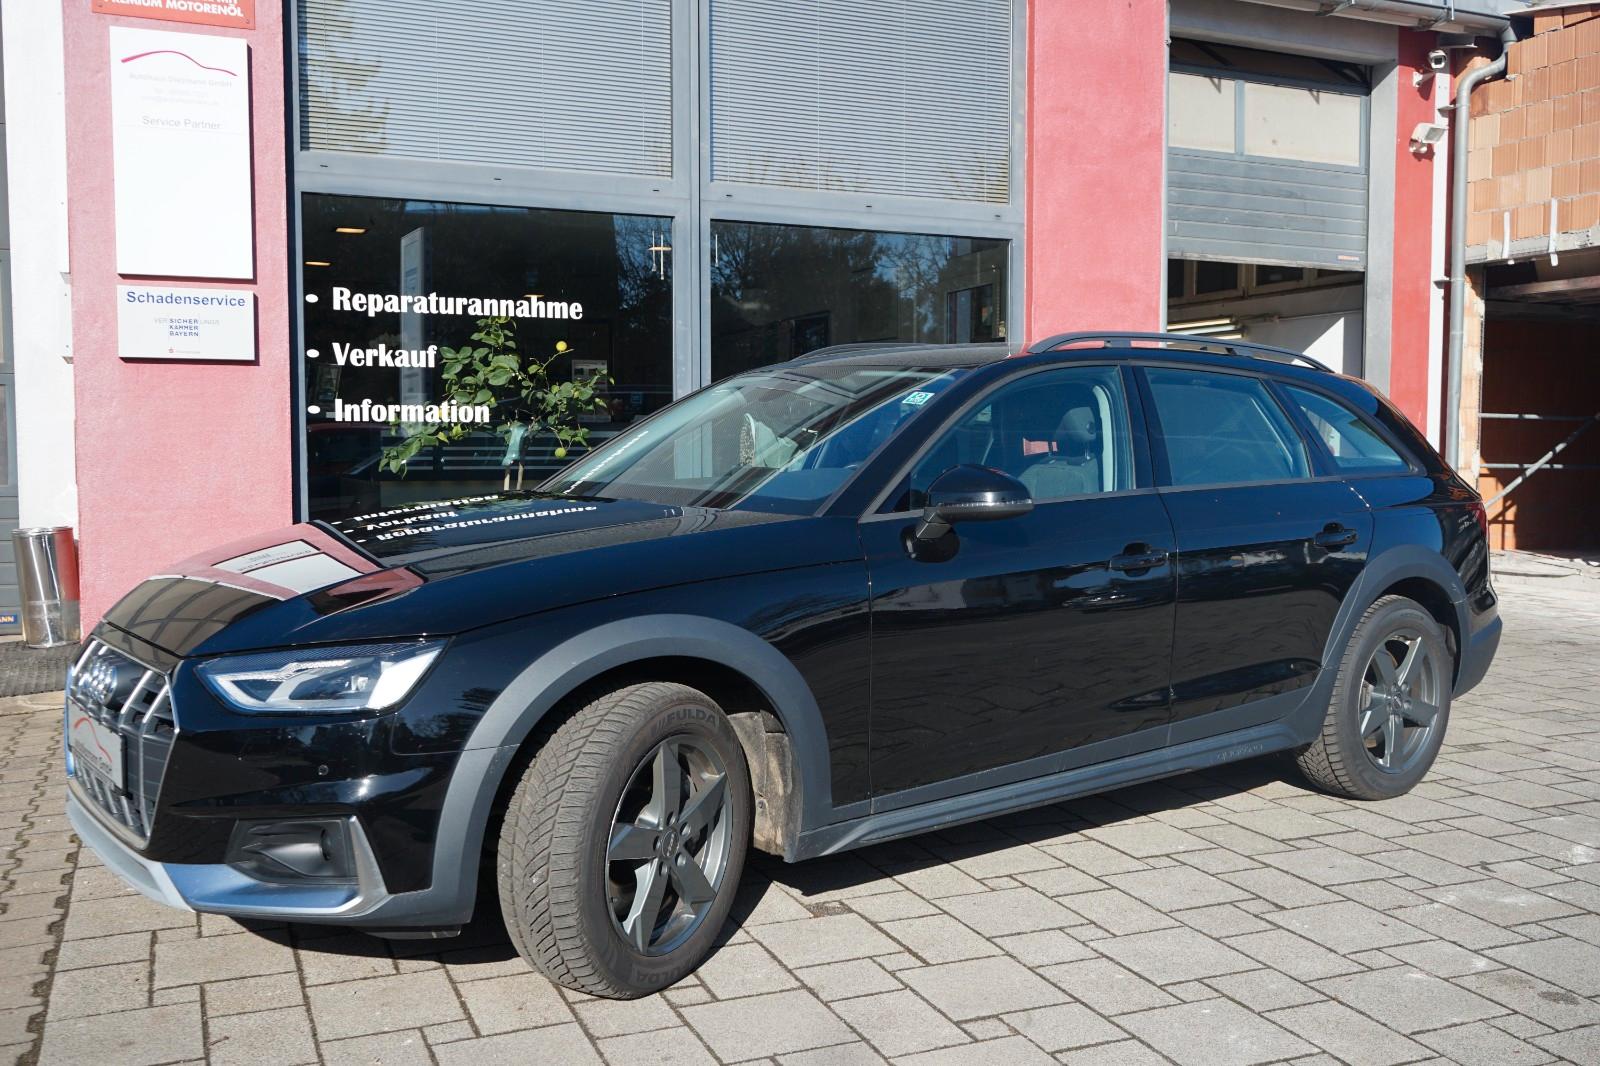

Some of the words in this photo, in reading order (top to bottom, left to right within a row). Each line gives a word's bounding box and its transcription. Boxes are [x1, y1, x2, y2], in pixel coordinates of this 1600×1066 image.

[104, 0, 163, 8] MIUM
[166, 0, 244, 17] MOTORENÖL
[142, 115, 181, 128] Service
[184, 118, 221, 130] Partner
[127, 291, 246, 306] Schadenservice
[332, 286, 583, 320] Reparaturannahme
[332, 342, 438, 368] Verkauf
[334, 399, 490, 423] Information
[666, 709, 716, 727] FULDA
